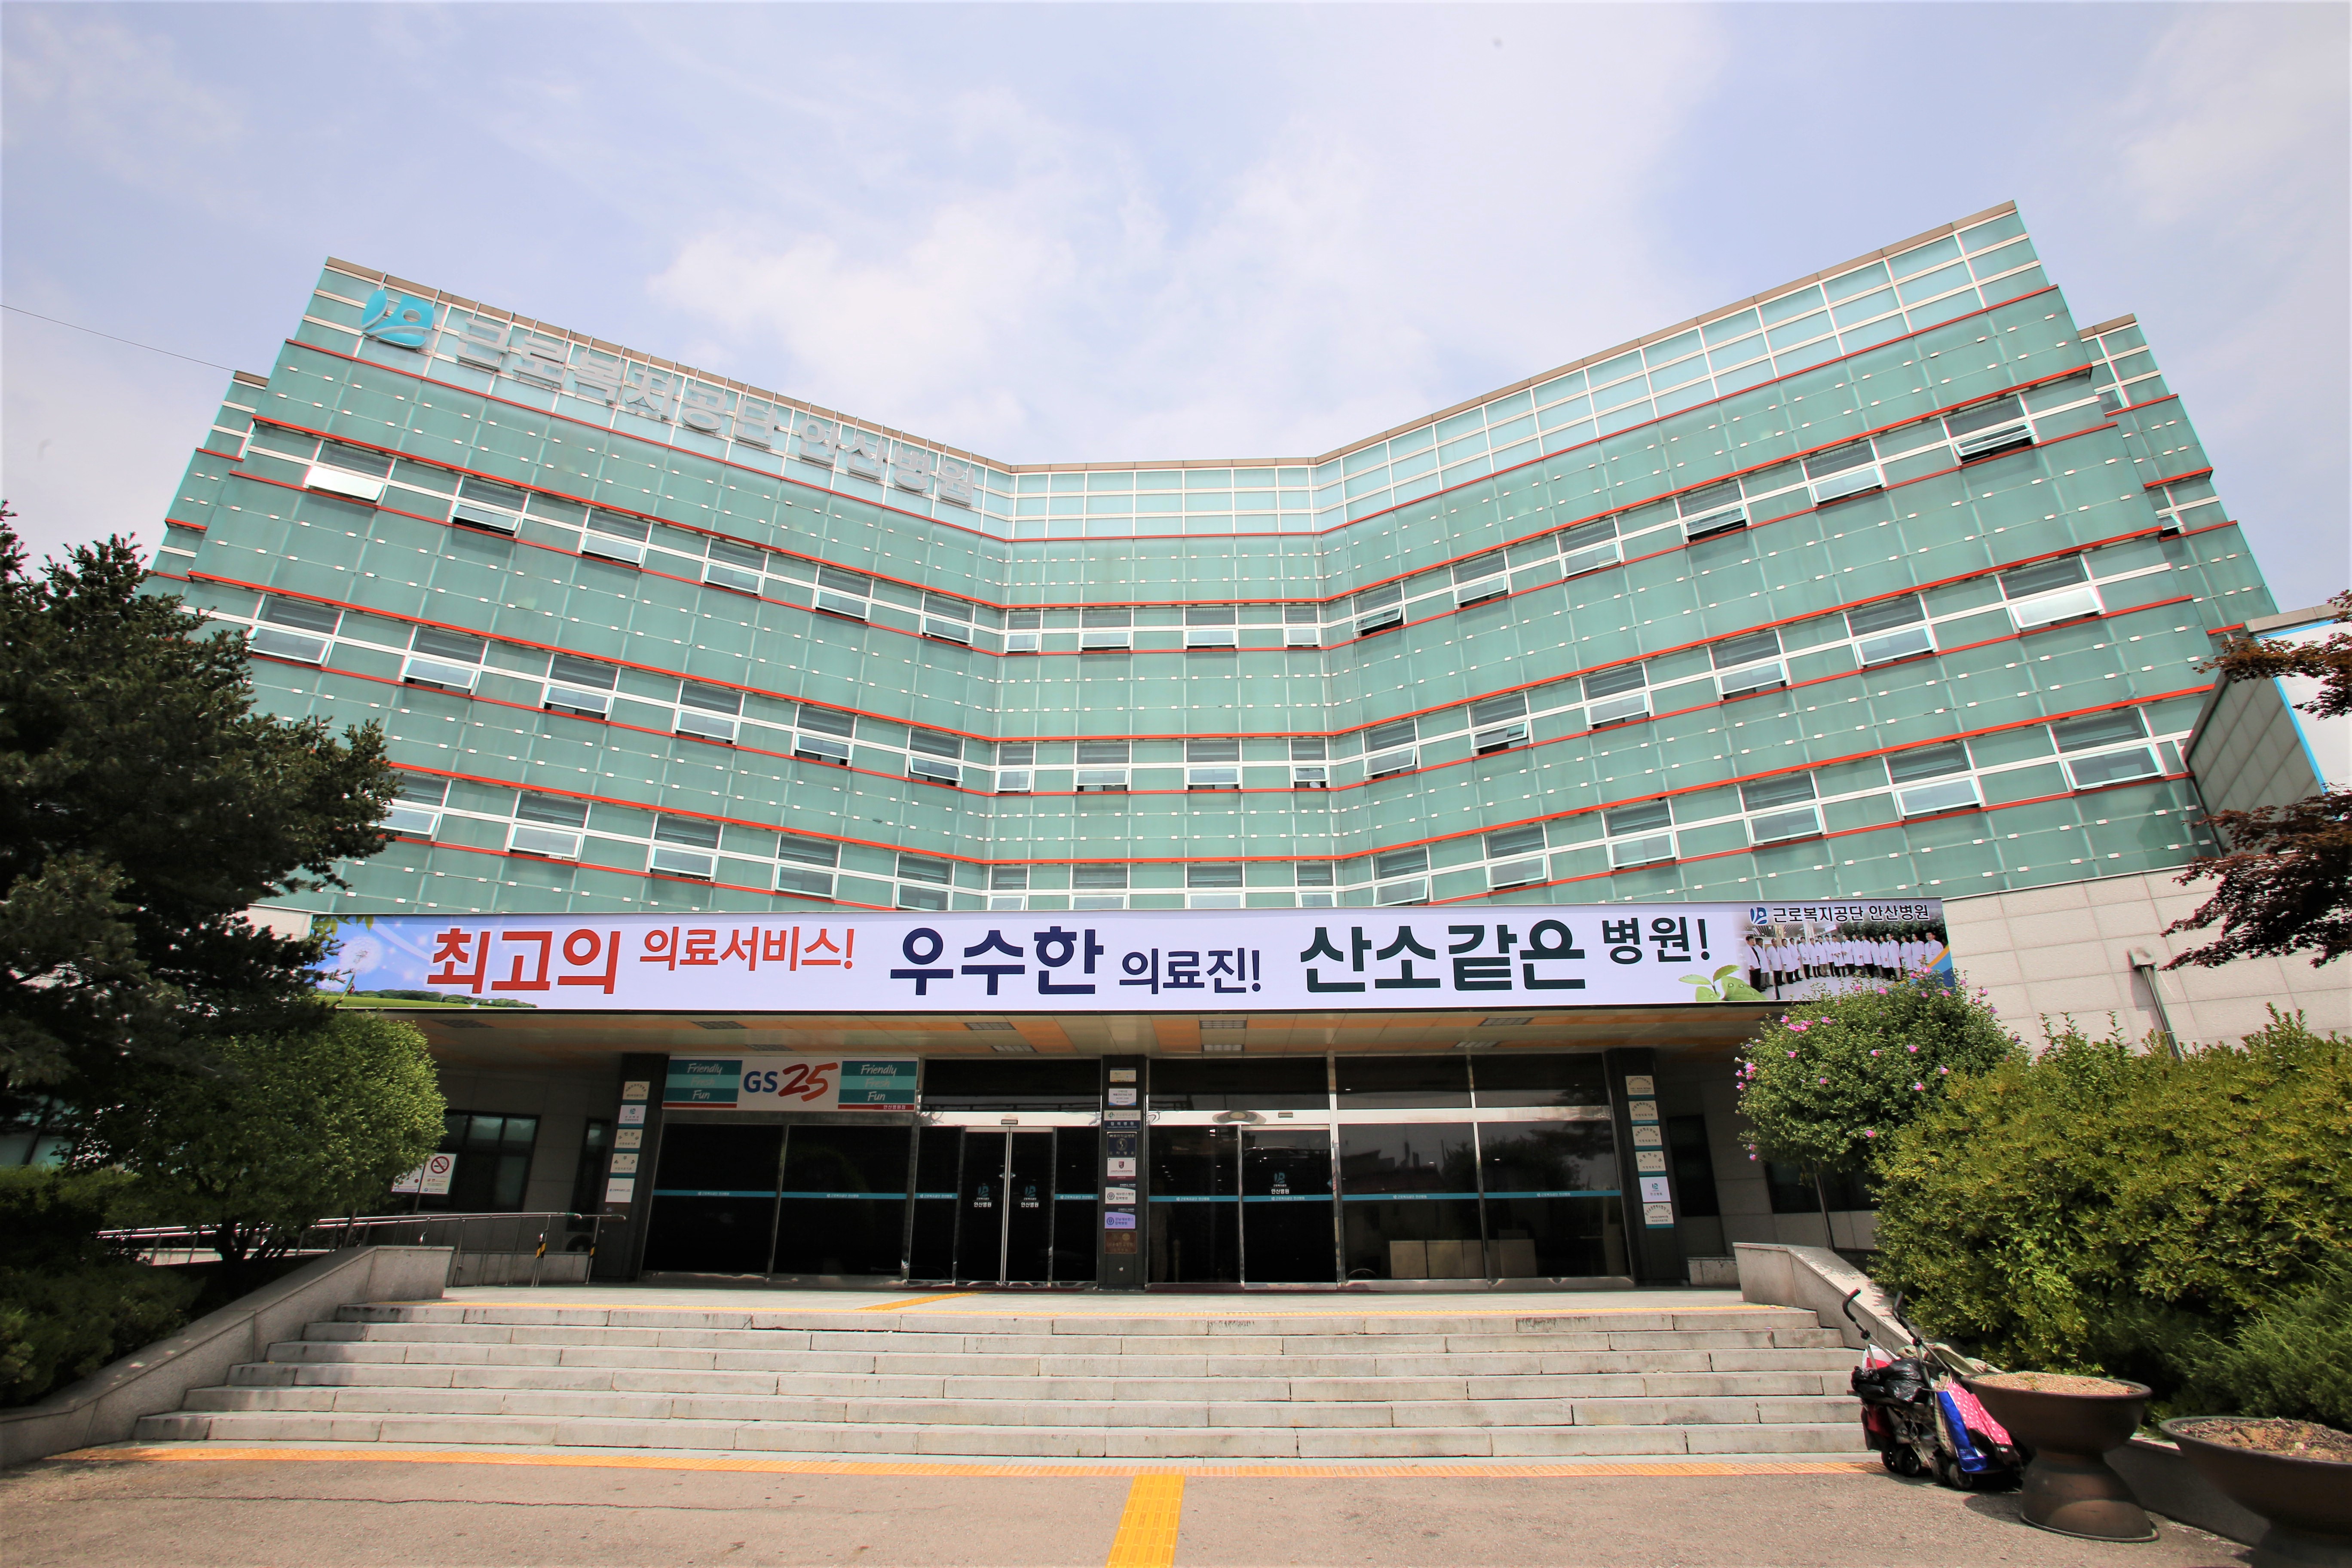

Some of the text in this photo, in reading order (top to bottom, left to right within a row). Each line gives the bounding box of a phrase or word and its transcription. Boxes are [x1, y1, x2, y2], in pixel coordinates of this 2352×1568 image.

[456, 318, 977, 506] 근로복지공단 안산병원
[1773, 904, 1929, 923] 근로복지공단 안산병원
[427, 916, 1710, 996] 최고의 의료서비스! 우수한 의료진! 산소같은 병원!
[687, 1063, 723, 1076] Friendly
[861, 1064, 897, 1077] Friendly
[690, 1076, 716, 1087] Fresh
[743, 1062, 838, 1102] GS25
[864, 1078, 891, 1088] Fresh
[692, 1090, 710, 1100] Fun
[867, 1091, 886, 1101] Fun
